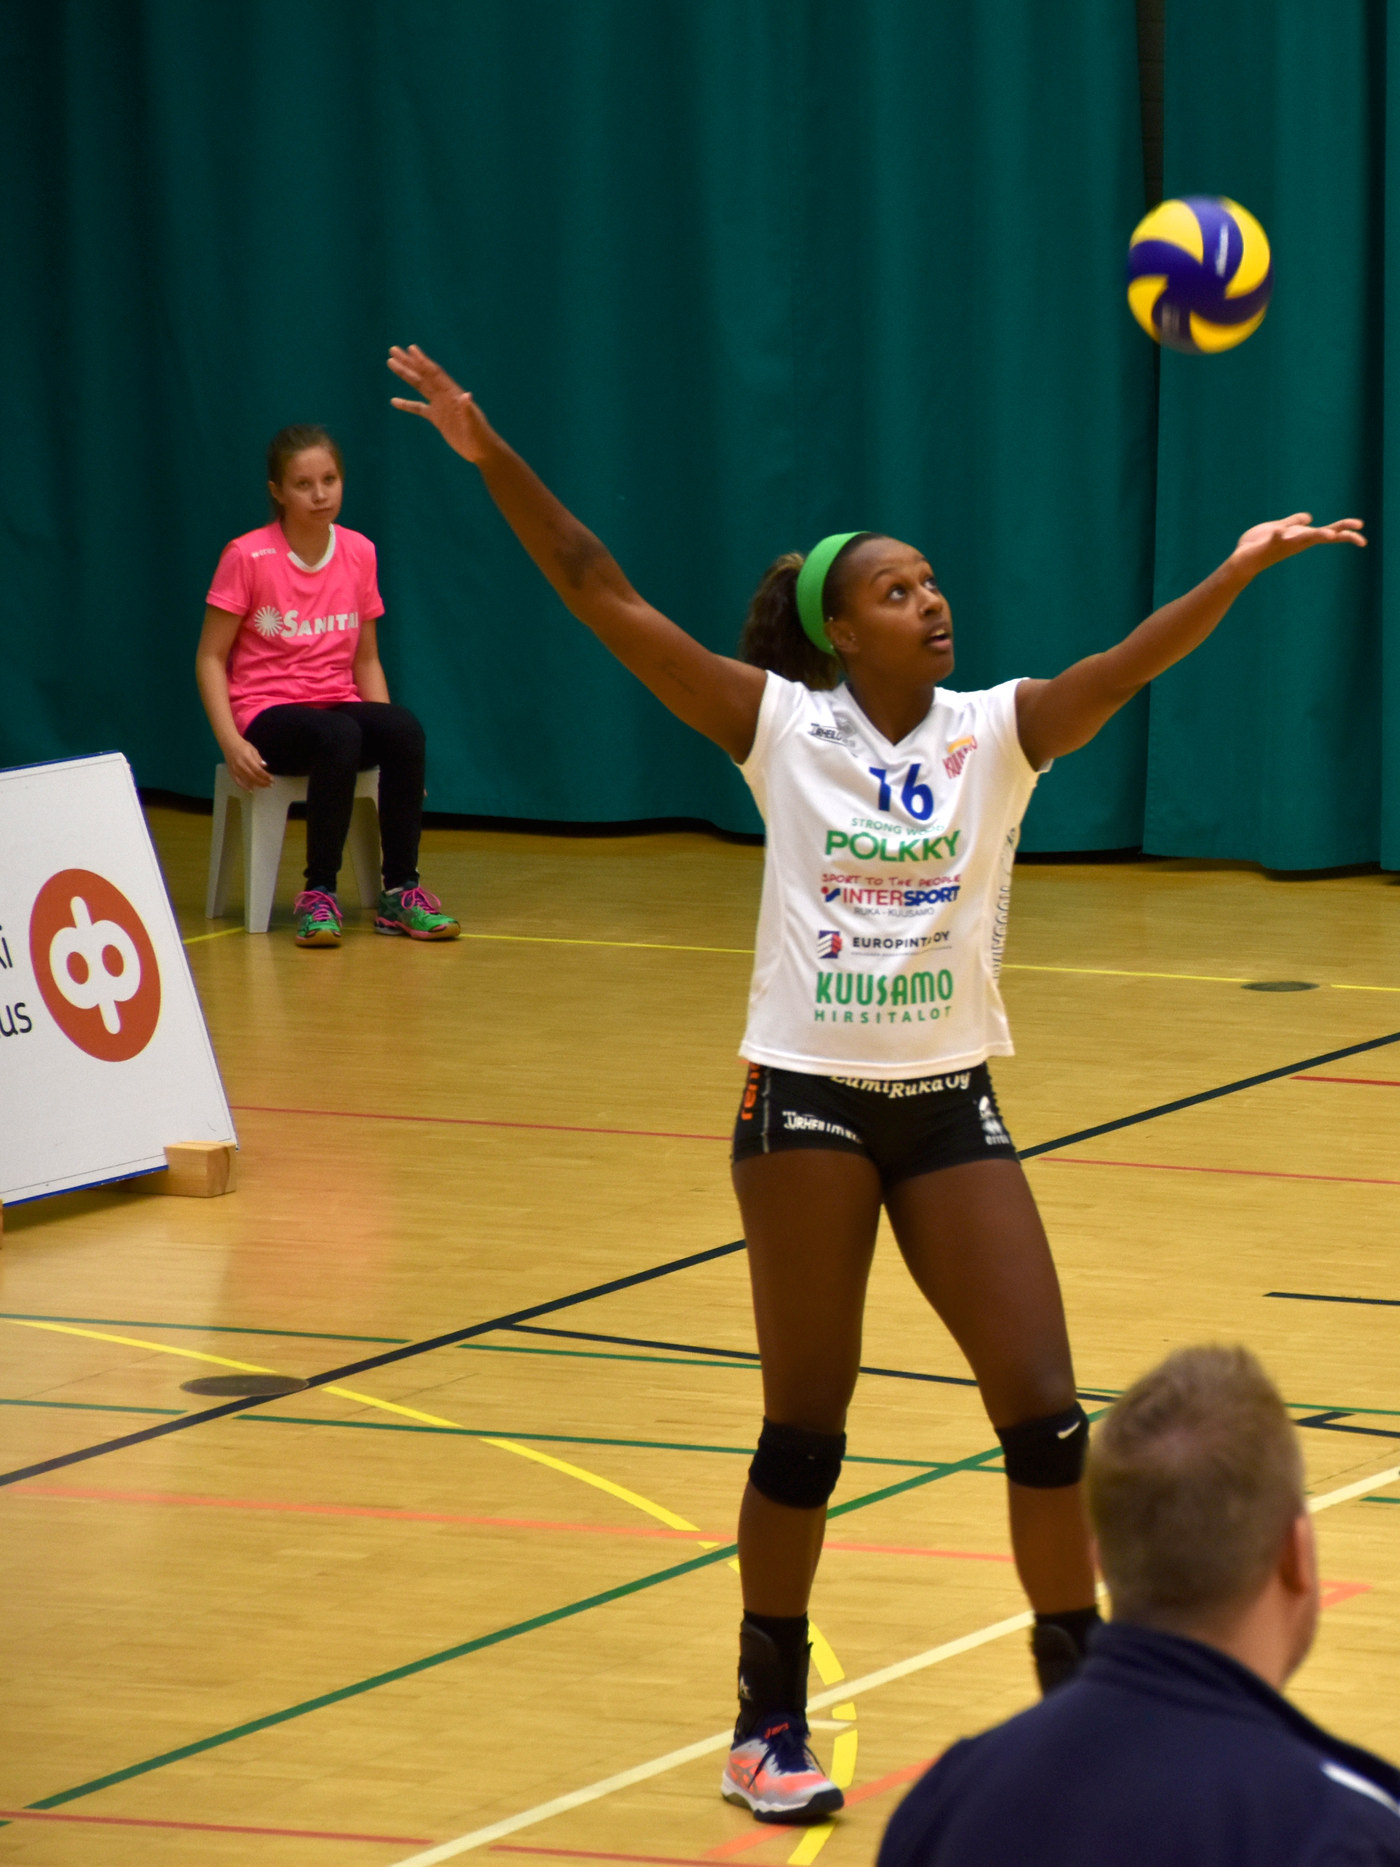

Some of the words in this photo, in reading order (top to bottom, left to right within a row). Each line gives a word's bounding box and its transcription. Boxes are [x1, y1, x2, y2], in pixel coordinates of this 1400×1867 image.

[868, 763, 934, 821] 16
[851, 817, 902, 835] STRONG
[821, 873, 861, 885] SPORT
[866, 876, 883, 887] TO
[918, 873, 961, 888] PEOPLE
[842, 885, 960, 907] INTERSPORT
[815, 968, 954, 1006] KUUSAMO
[814, 1005, 952, 1024] HIRSITALOT
